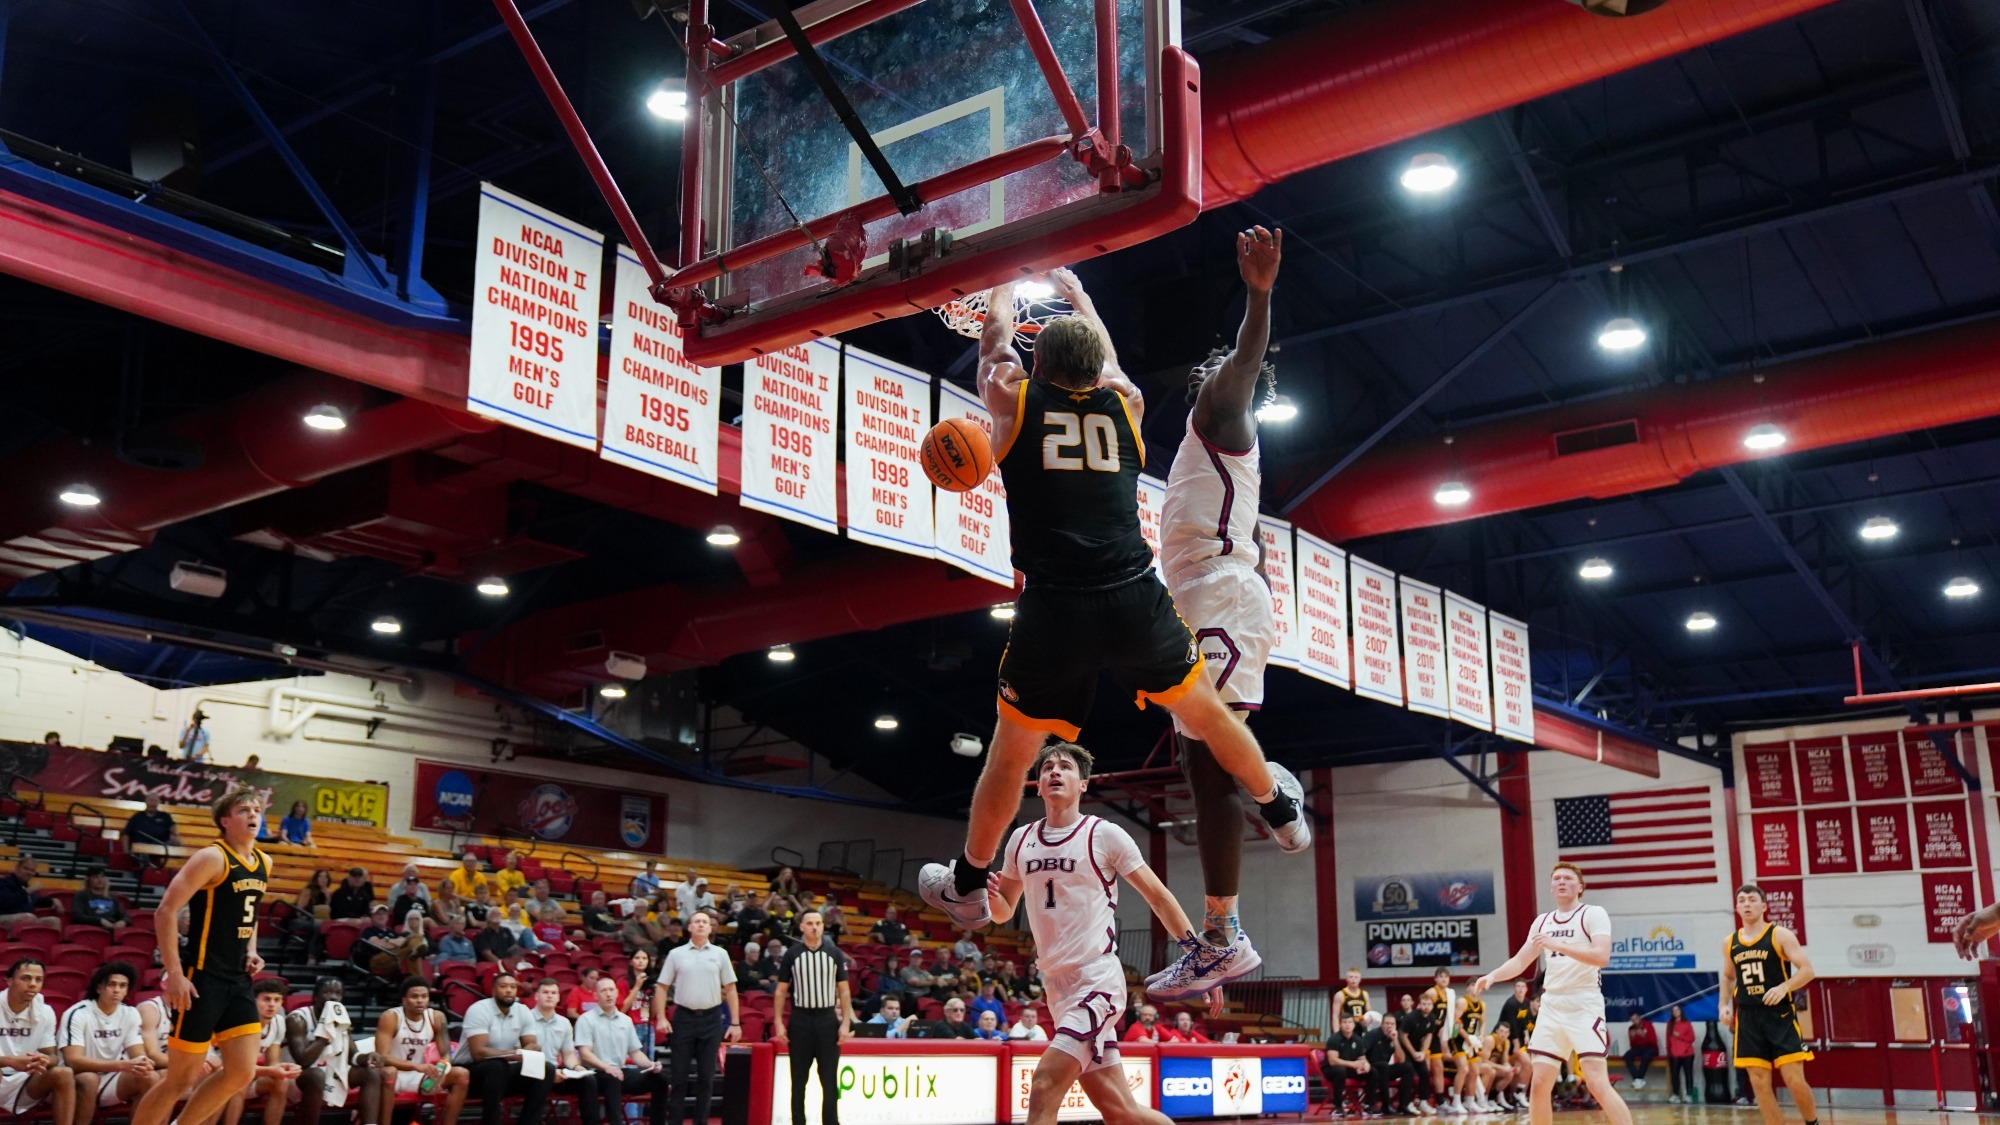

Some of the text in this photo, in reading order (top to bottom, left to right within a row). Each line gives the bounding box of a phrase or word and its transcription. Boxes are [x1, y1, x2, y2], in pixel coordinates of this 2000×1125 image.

[522, 224, 563, 258] NCAA
[493, 238, 587, 289] DIVISION II
[500, 266, 578, 311] NATIONAL
[488, 286, 587, 337] CHAMPIONS
[628, 301, 684, 339] DIVISIO
[510, 321, 564, 362] 1995
[509, 356, 560, 388] MEN'S
[623, 357, 708, 406] CHAMPIONS
[757, 355, 828, 391] DIVISION II
[514, 382, 554, 410] GOLF
[763, 376, 822, 411] NATIONAL
[874, 376, 903, 399] NCAA
[640, 393, 689, 432] 1995
[754, 395, 830, 434] CHAMPIONS
[857, 390, 920, 424] DIVISION II
[863, 413, 916, 443] NATIONAL
[626, 424, 698, 465] BASEBALL
[770, 424, 812, 457] 1996
[855, 431, 921, 464] CHAMPIONS
[1043, 411, 1120, 473] 20
[772, 454, 810, 479] MEN'S
[871, 459, 908, 487] 1998
[775, 477, 806, 499] GOLF
[872, 487, 907, 509] MEN'S
[960, 490, 993, 518] 1999
[876, 509, 904, 529] GOLF
[959, 513, 990, 538] MEN'S
[961, 534, 986, 555] GOLF
[1314, 552, 1330, 569] NCAA
[1304, 566, 1333, 591] DIVISION
[1366, 576, 1381, 591] NCAA
[1308, 586, 1337, 610] NATIONAL
[1358, 587, 1384, 606] DIVISION
[1414, 595, 1428, 608] NCAA
[1304, 604, 1341, 630] CHAMPIONS
[1361, 603, 1389, 623] NATIONAL
[1407, 606, 1431, 622] DIVISION
[1459, 610, 1473, 624] NCAA
[1311, 626, 1335, 649] 2005
[1358, 617, 1392, 638] CHAMPIONS
[1410, 622, 1436, 638] NATIONAL
[1451, 619, 1476, 638] DIVISION
[1503, 629, 1516, 641] NCAA
[1366, 635, 1387, 654] 2007
[1408, 635, 1440, 652] CHAMPIONS
[1454, 634, 1479, 653] NATIONAL
[1496, 639, 1518, 655] DIVISION
[1308, 648, 1340, 670] BASEBALL
[1364, 654, 1391, 672] WOMEN'S
[1417, 652, 1435, 670] 2010
[1452, 646, 1483, 668] CHAMPIONS
[1499, 653, 1522, 669] NATIONAL
[1370, 671, 1386, 685] GOLF
[1418, 672, 1435, 685] MEN'S
[1459, 664, 1477, 683] 2016
[1496, 665, 1526, 683] CHAMPIONS
[1421, 686, 1434, 699] GOLF
[1504, 682, 1520, 699] 2017
[1456, 695, 1484, 714] LACROSSE
[1508, 714, 1520, 726] GOLF
[1808, 748, 1831, 759] NCAA
[1862, 744, 1886, 754] NCAA
[1917, 740, 1936, 749] NCA
[1756, 753, 1780, 763] NCAA
[101, 767, 212, 803] Snake
[438, 791, 473, 807] NCAA
[1763, 822, 1787, 832] NCAA
[1816, 819, 1841, 829] NCAA
[1870, 816, 1895, 825] NCAA
[1926, 812, 1954, 822] NCAA
[1025, 857, 1077, 875] DBU
[1045, 878, 1057, 909] 1
[1766, 891, 1794, 901] NCAA
[1934, 884, 1963, 895] NCAA
[242, 895, 257, 923] 5
[1368, 920, 1472, 941] POWERADE
[1414, 941, 1452, 955] NCAA
[1631, 936, 1684, 952] Florida
[1733, 949, 1769, 964] MICHIGAN
[1740, 961, 1765, 985] 24
[1746, 985, 1765, 995] TECH
[837, 1065, 937, 1100] Publix
